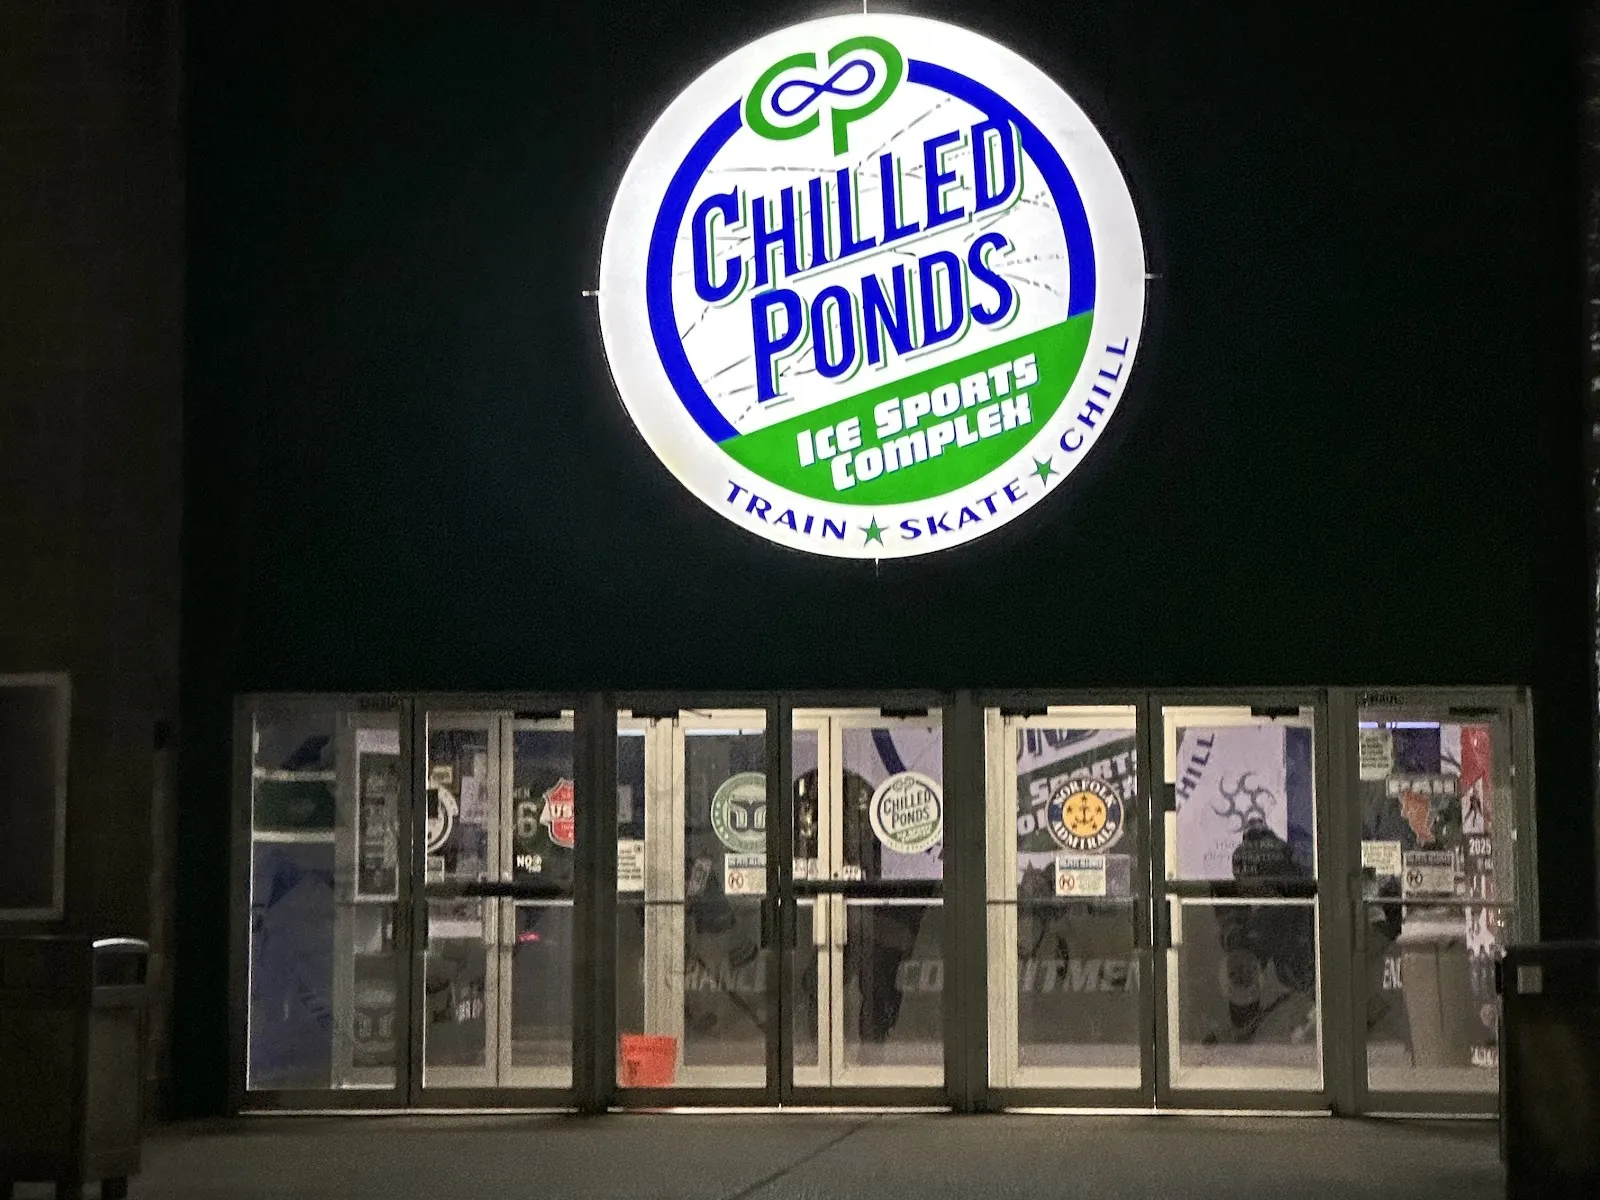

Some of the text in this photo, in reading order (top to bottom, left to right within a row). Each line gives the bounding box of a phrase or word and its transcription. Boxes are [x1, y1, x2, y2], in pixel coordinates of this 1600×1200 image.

[691, 119, 1023, 305] CHILLED
[751, 232, 1019, 407] PONDS
[725, 336, 1129, 541] TRAIN SKATE CHILL
[796, 354, 1040, 467] ICE SPORTS
[830, 393, 1034, 492] COMPLEX
[883, 789, 932, 816] CHILLED
[891, 806, 930, 829] PONDS
[1053, 780, 1117, 807] NORFOLK
[1176, 733, 1215, 814] HILL
[1053, 820, 1116, 850] ADMIRALS
